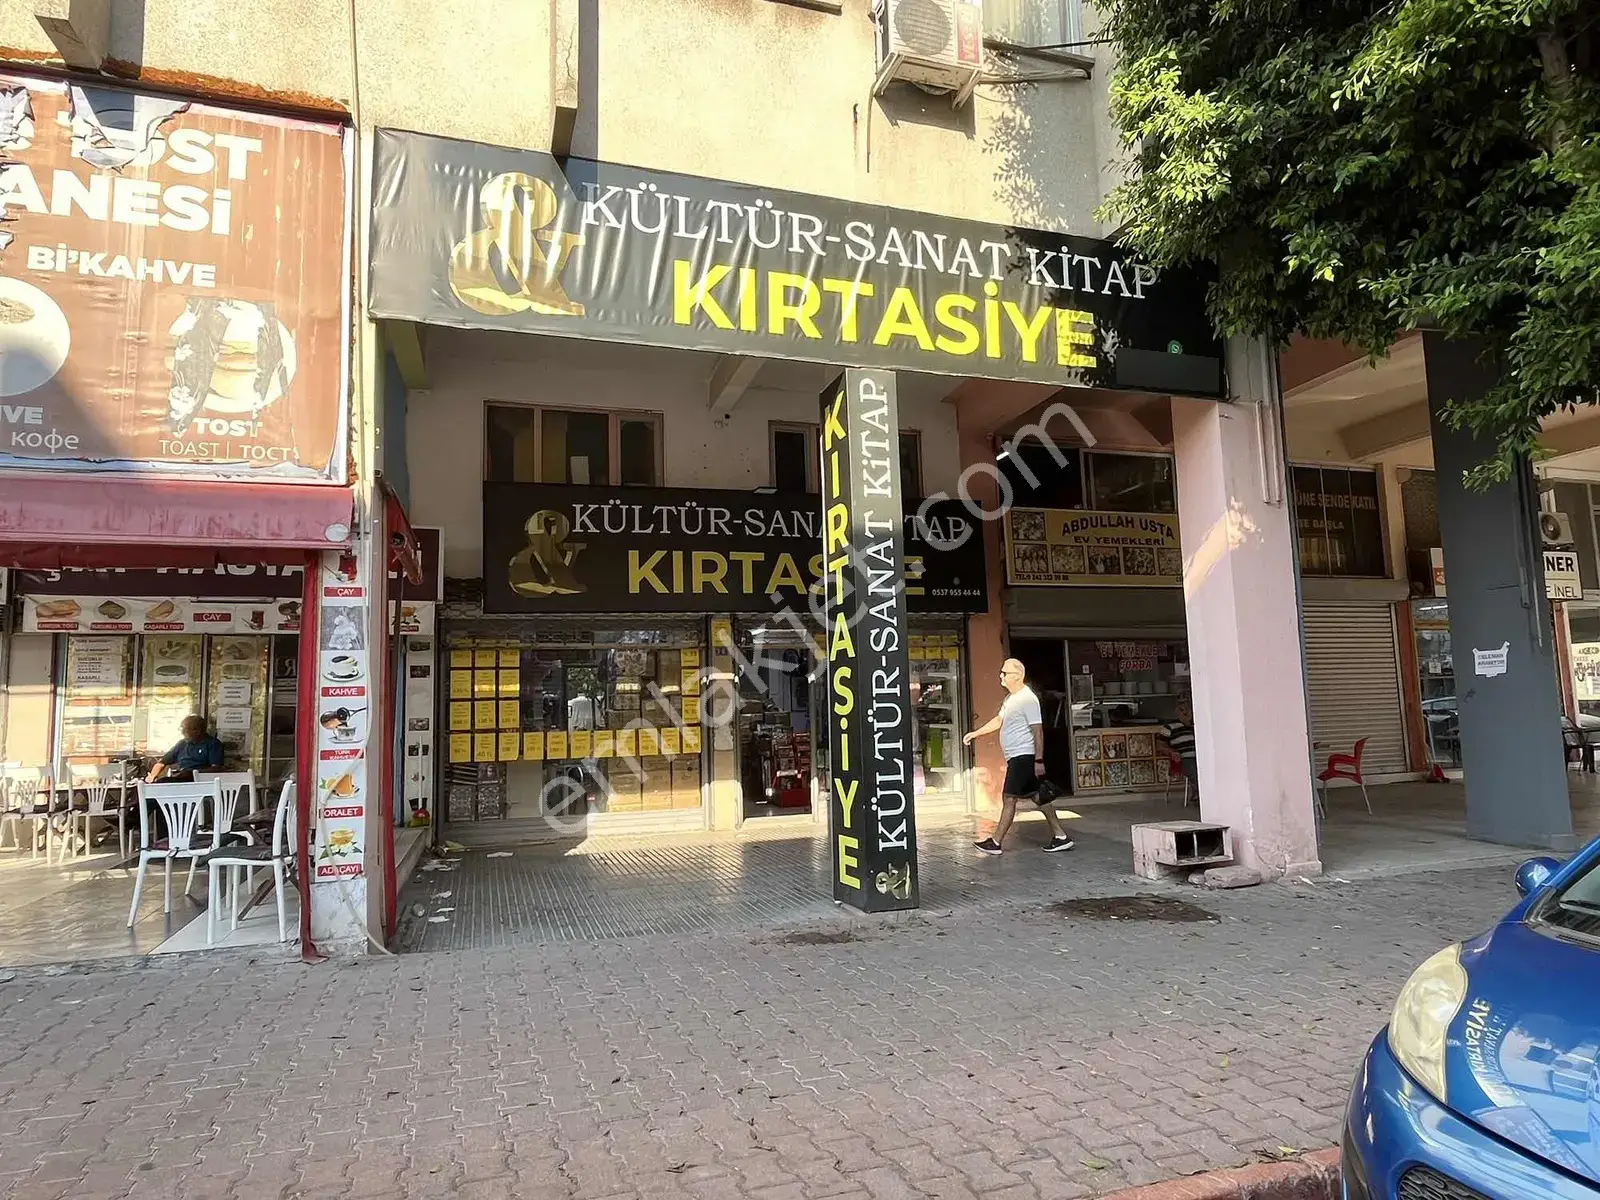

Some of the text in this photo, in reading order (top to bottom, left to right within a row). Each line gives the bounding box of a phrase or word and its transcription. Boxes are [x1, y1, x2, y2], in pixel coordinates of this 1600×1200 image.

[581, 181, 1158, 299] KÜLTÜR-SANAT KİTAP
[673, 259, 1097, 368] KIRTASİYE
[192, 417, 264, 438] TOST
[159, 439, 221, 458] TOAST
[1062, 515, 1176, 541] ABDULLAH USTA
[1074, 536, 1090, 544] EV
[337, 588, 355, 598] ÇAY
[203, 612, 222, 624] ÇAY
[824, 390, 861, 890] KIRTASİYE
[863, 510, 908, 852] KÜLTÜR-SANAT
[328, 687, 359, 696] KAHVE
[324, 808, 359, 818] ORALET
